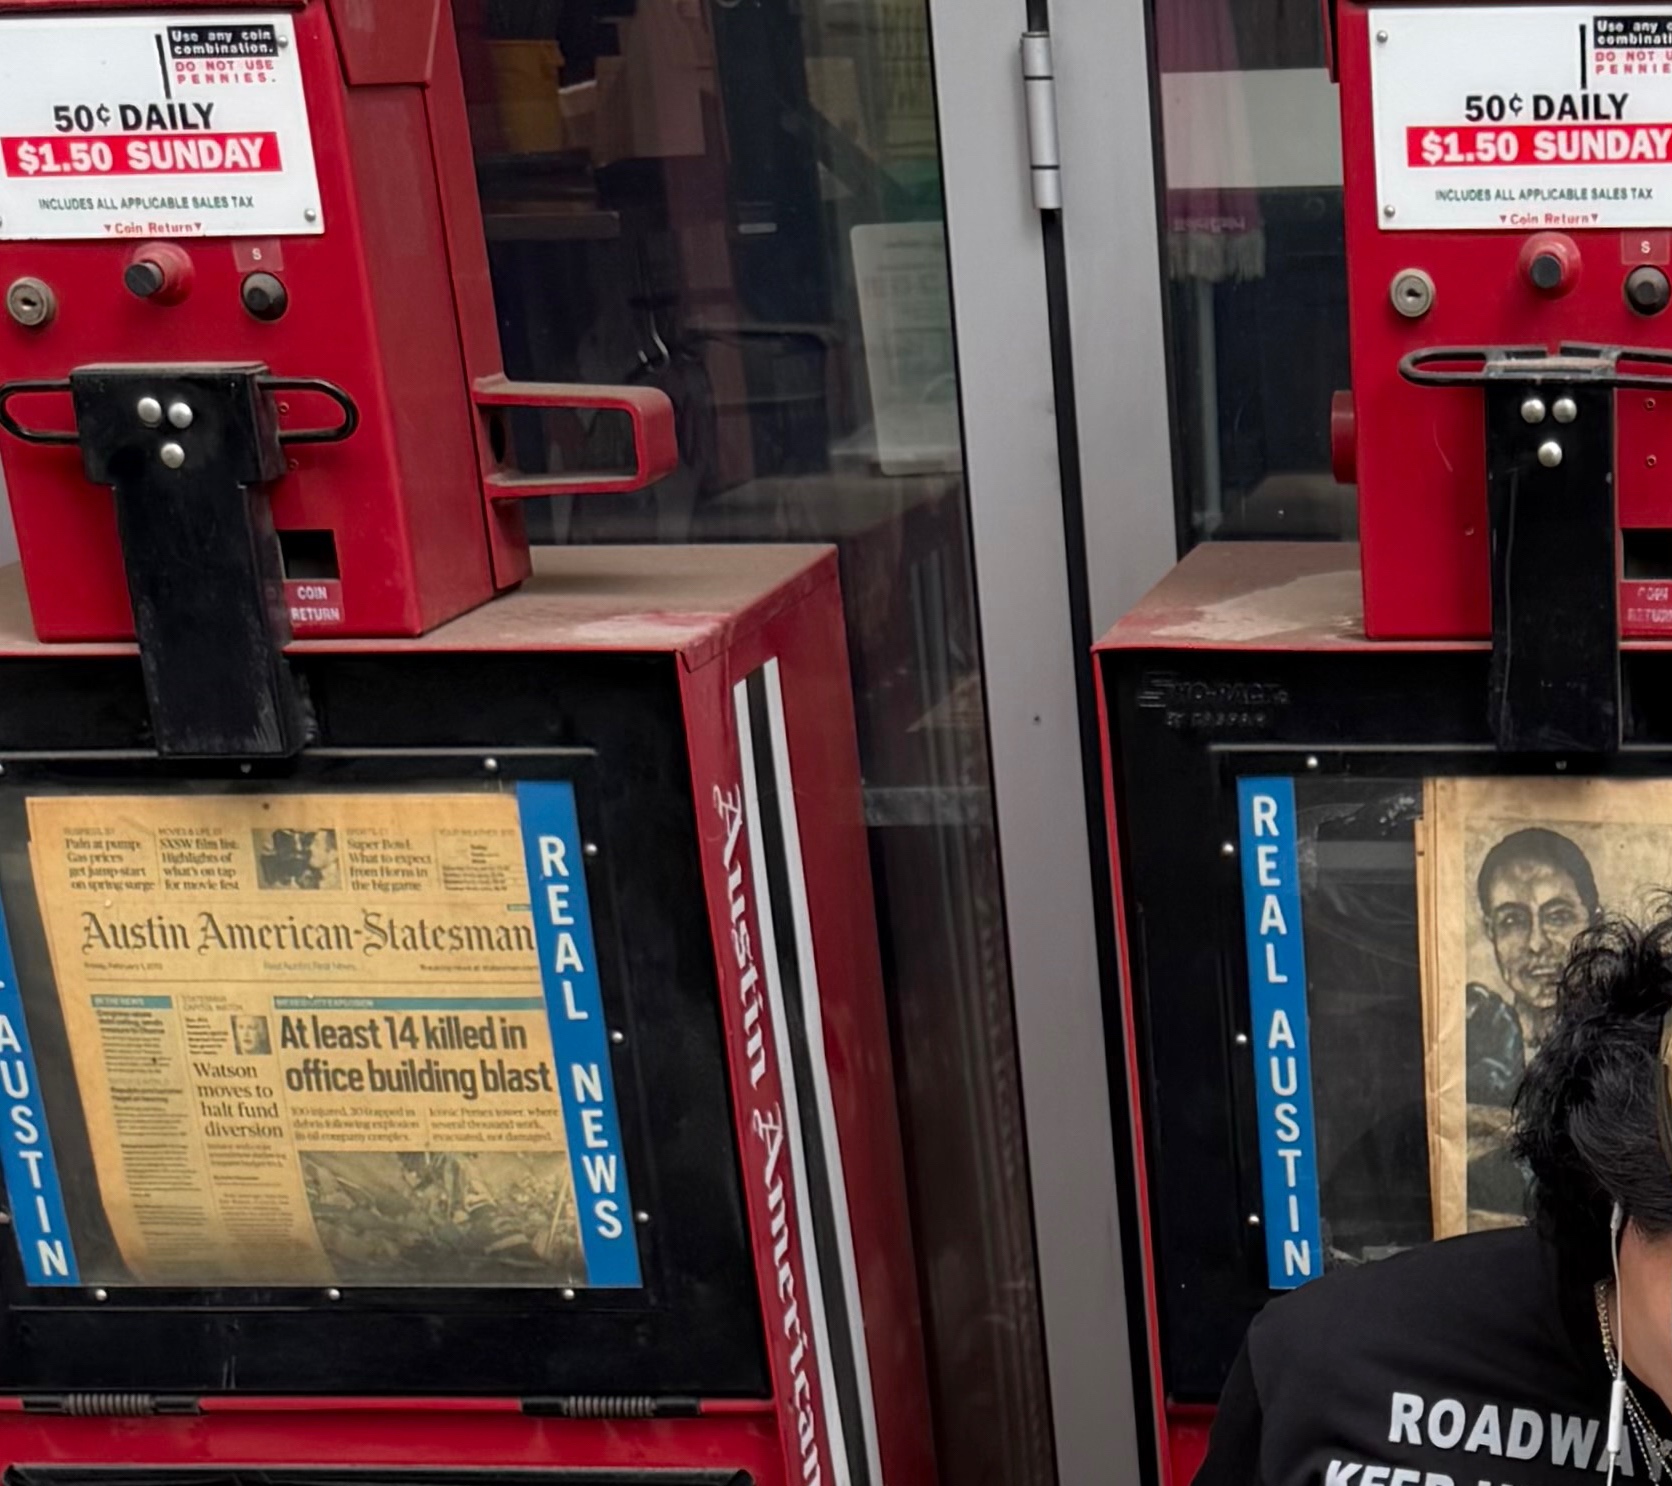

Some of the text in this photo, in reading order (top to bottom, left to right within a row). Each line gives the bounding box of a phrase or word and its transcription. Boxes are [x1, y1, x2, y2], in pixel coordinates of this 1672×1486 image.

[172, 30, 271, 43] Use any coin
[1597, 21, 1623, 33] Use
[1633, 23, 1658, 35] any
[174, 42, 273, 54] combination.
[1595, 51, 1616, 62] DO
[1626, 51, 1655, 61] NOT
[176, 60, 273, 72] DO NOT USE
[177, 73, 276, 84] PENNIES.
[1465, 93, 1629, 122] 50¢ DAILY
[53, 102, 214, 132] 50¢ DAILY
[1421, 129, 1672, 165] $1.50 SUNDAY
[18, 138, 264, 174] $1.50 SUNDAY
[38, 196, 254, 210] INCLUDES ALL APPLICABLE SALES TAX
[1435, 188, 1653, 201] INCLUDES ALL APPLICABLE SALES TAX
[1510, 213, 1588, 225] Coin Return
[115, 222, 193, 234] Coin Return
[297, 586, 328, 600] COIN
[290, 607, 340, 621] RETURN
[1252, 796, 1288, 984] REAL
[81, 908, 537, 956] Austin American-Statesman
[538, 836, 588, 1020] REAL
[714, 782, 767, 1090] Austin
[280, 1015, 527, 1049] At least 14 killed in
[193, 1062, 257, 1079] Watson
[285, 1058, 553, 1101] office building blast
[197, 1086, 273, 1099] moves to
[201, 1102, 279, 1119] halt fund
[205, 1121, 284, 1138] diversion
[0, 1015, 68, 1276] AUSTIN
[571, 1063, 624, 1240] NEWS
[1267, 1010, 1312, 1277] AUSTIN
